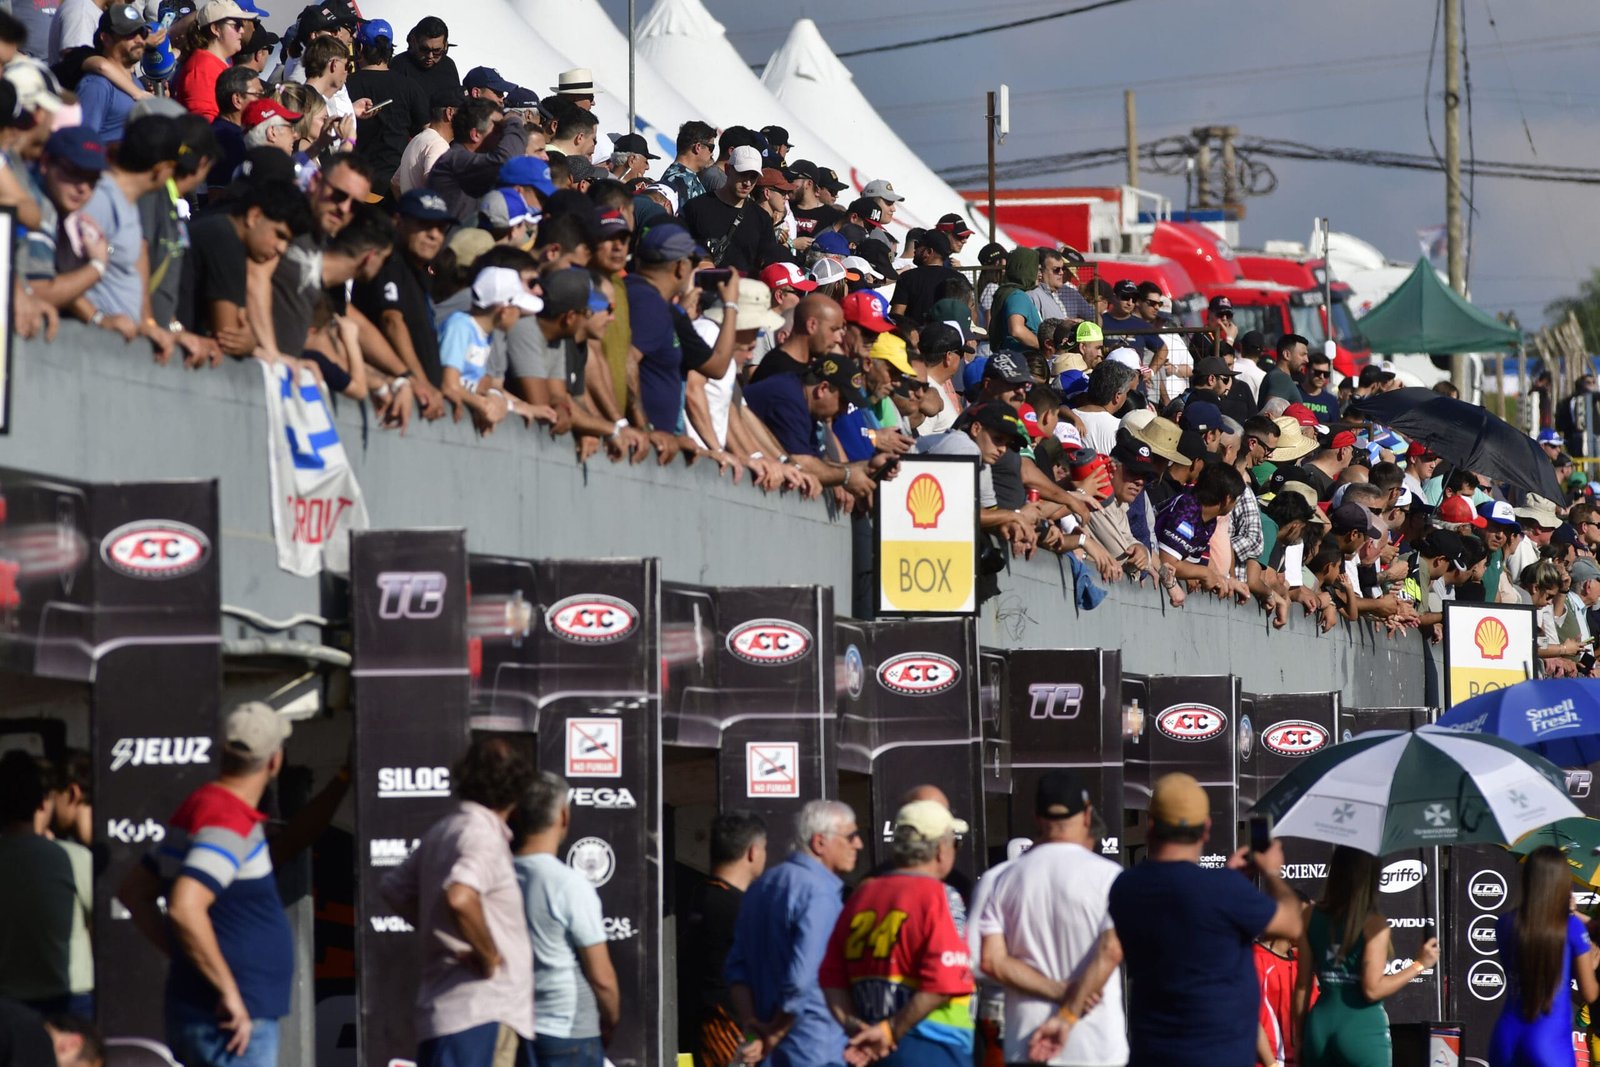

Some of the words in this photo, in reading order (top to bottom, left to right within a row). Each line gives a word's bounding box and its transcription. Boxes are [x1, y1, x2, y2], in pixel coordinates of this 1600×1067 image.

[129, 538, 180, 560] ACTC
[899, 557, 952, 592] BOX
[377, 571, 447, 619] TC
[570, 609, 613, 628] ACTC
[748, 632, 790, 650] ACTC
[897, 664, 939, 683] ACTC
[1469, 680, 1514, 699] BO
[1029, 683, 1083, 719] TC
[1526, 698, 1575, 722] Smell
[1173, 713, 1209, 730] ACTC
[1531, 710, 1580, 732] Fresh
[1277, 730, 1312, 746] ACTC
[131, 736, 211, 766] JELUZ
[378, 766, 450, 791] SILOC
[754, 782, 765, 792] NO
[1279, 863, 1332, 879] SCIENZ
[1378, 867, 1421, 887] griffo
[1474, 884, 1502, 894] LCA
[845, 910, 908, 960] 24
[1474, 974, 1502, 985] LCA
